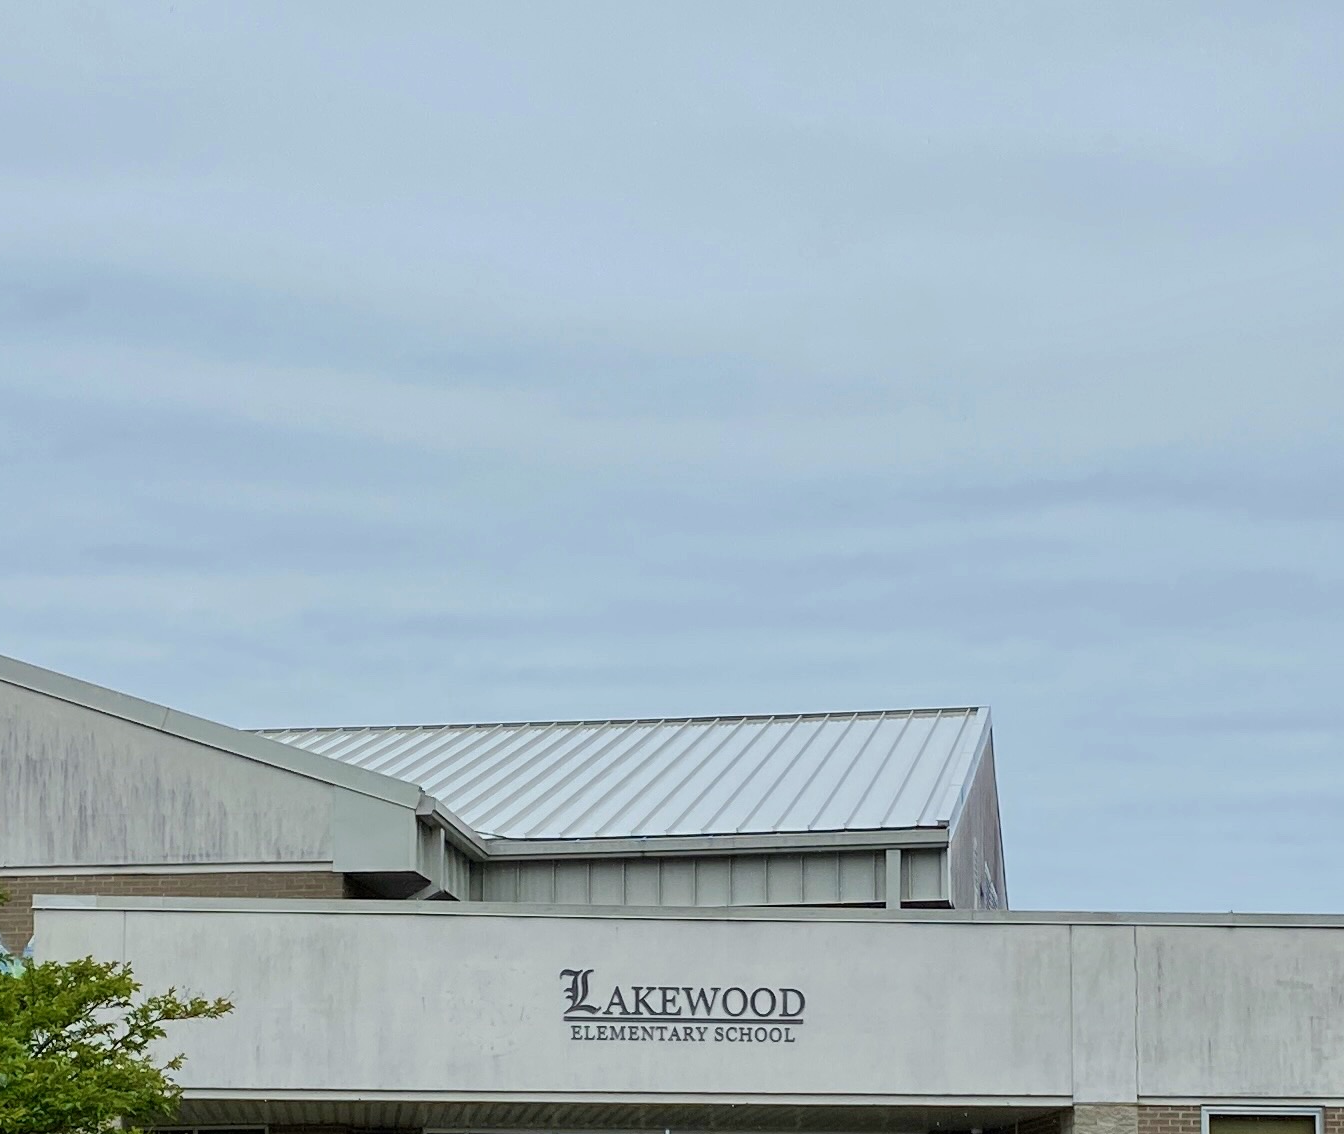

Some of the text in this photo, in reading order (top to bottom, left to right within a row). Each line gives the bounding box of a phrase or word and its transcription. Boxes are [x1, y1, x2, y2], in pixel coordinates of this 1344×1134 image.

[559, 968, 806, 1017] LAKEWOOD
[570, 1025, 796, 1043] ELEMENTARY SCHOOL
